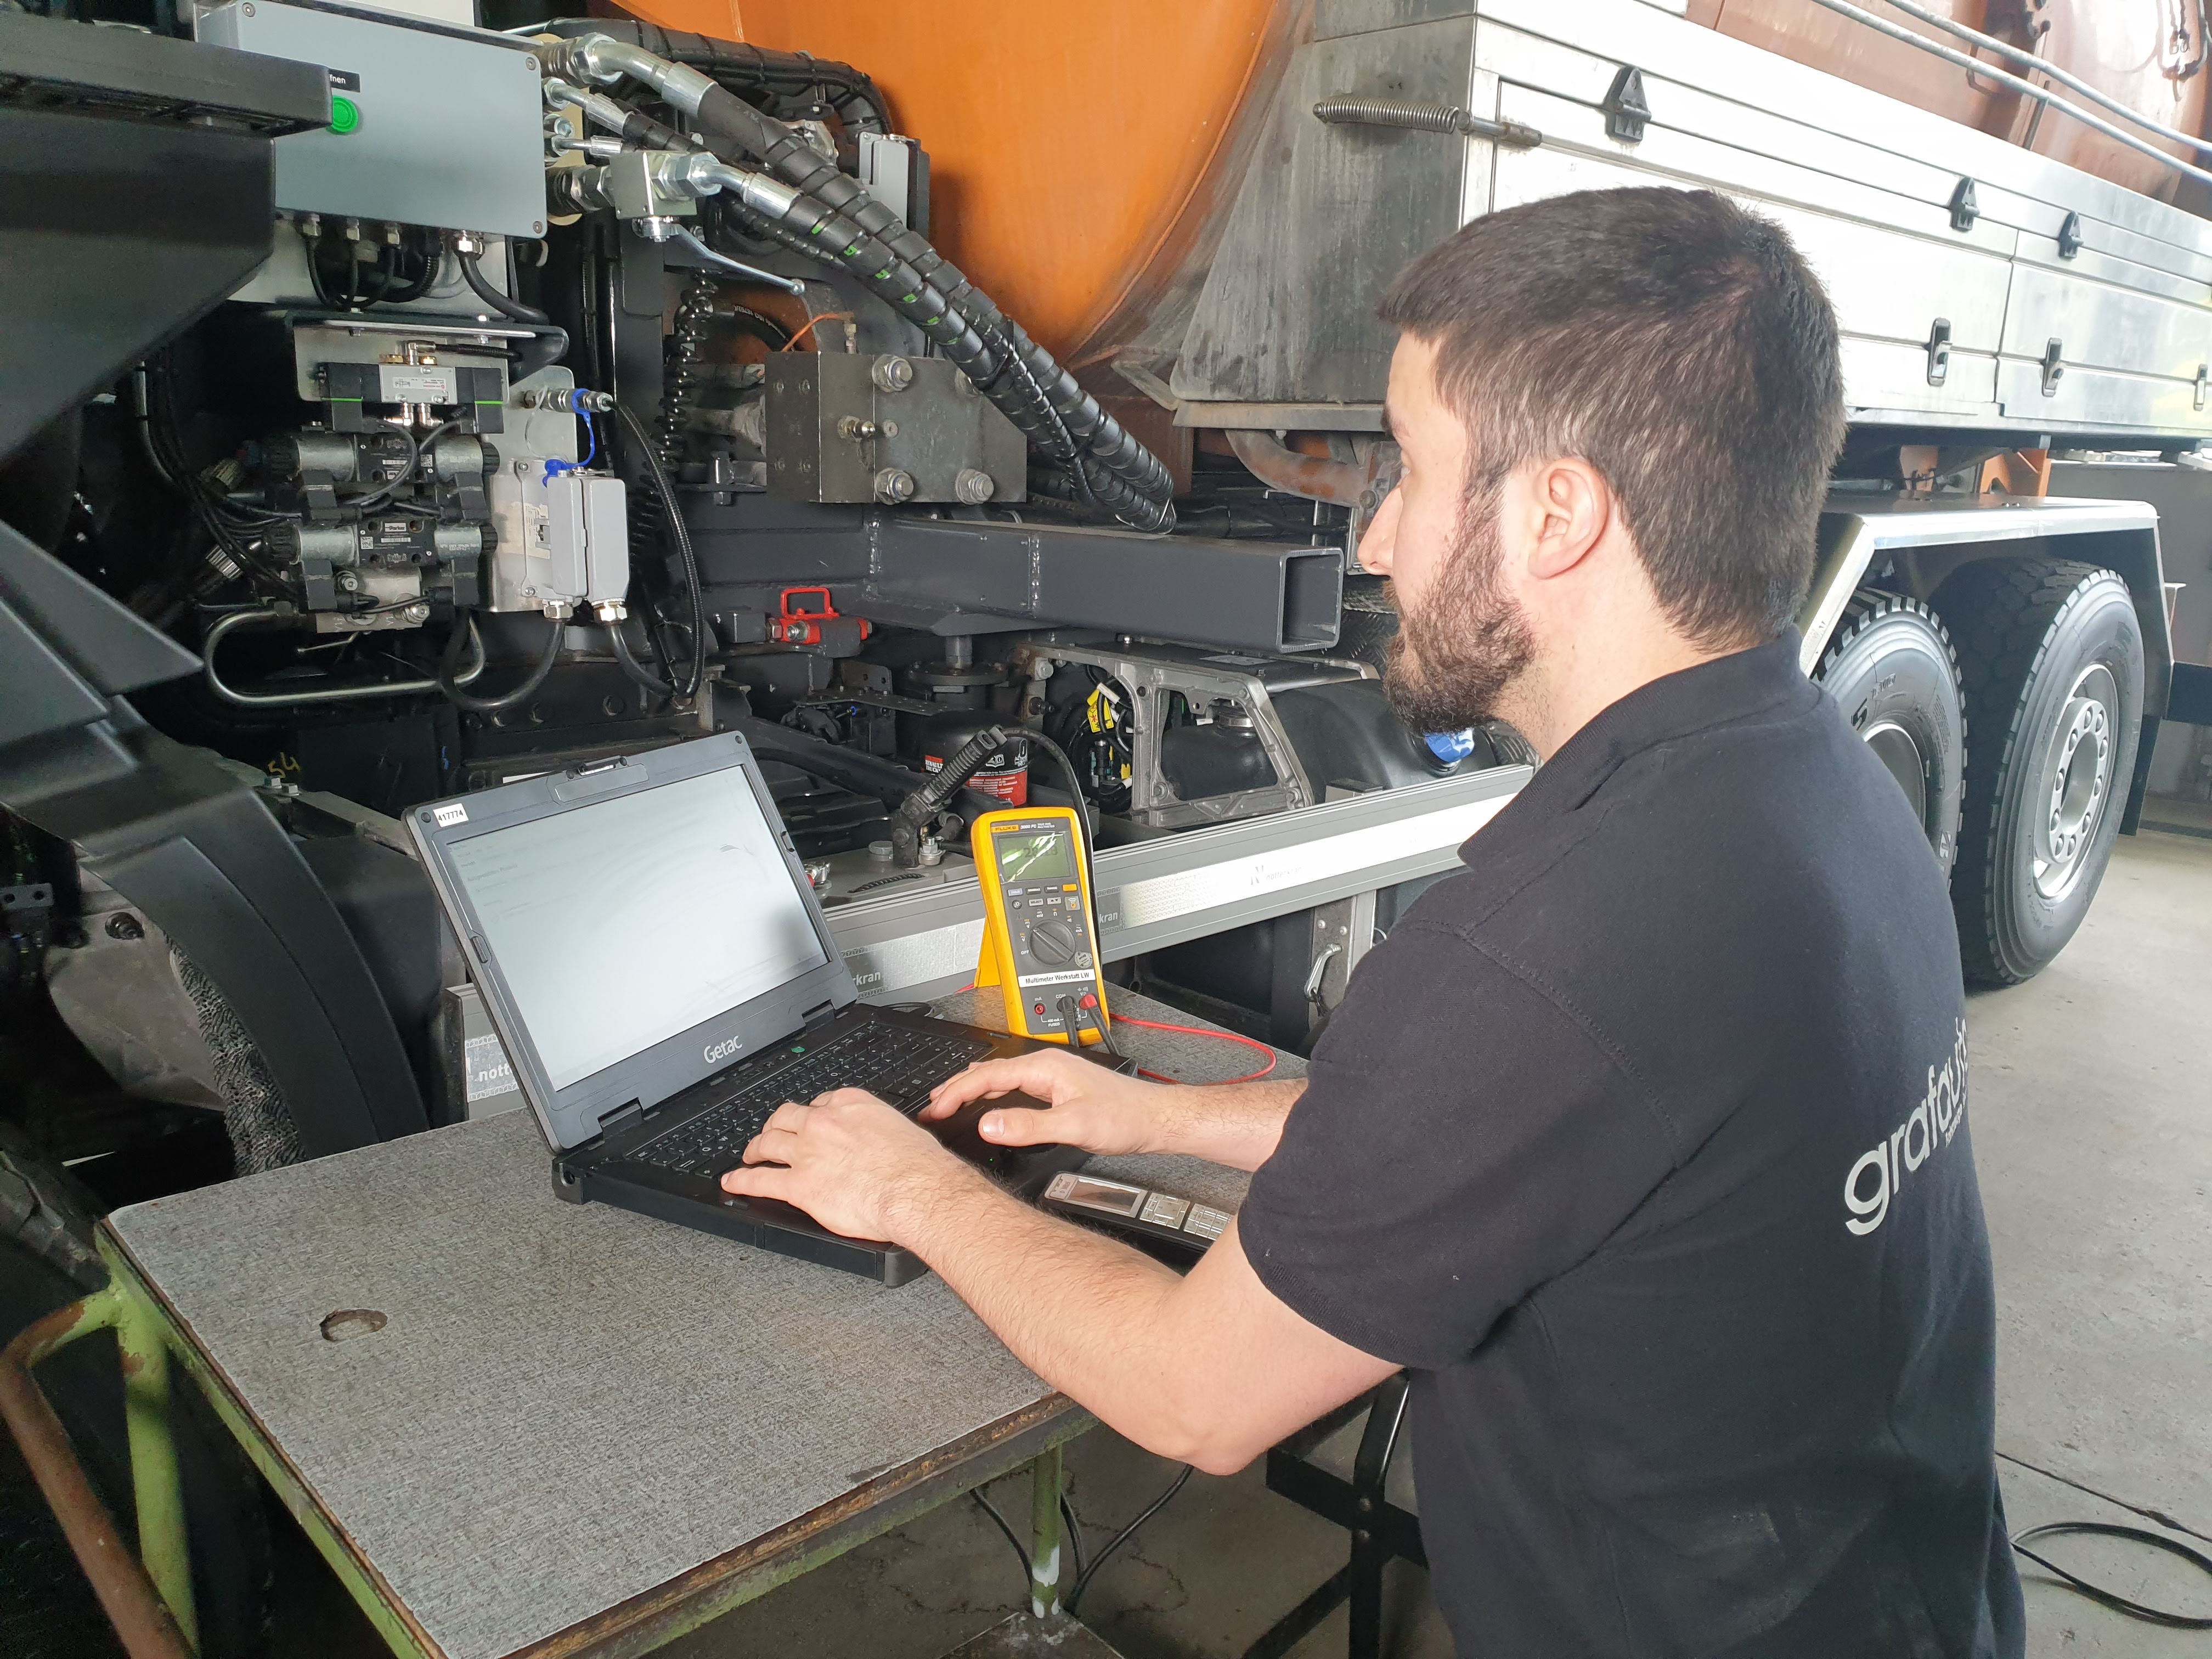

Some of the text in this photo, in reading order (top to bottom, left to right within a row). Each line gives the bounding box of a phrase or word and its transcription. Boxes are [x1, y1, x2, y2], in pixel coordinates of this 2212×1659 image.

[926, 765, 941, 774] TRUCK
[438, 810, 463, 821] 417774
[853, 972, 881, 986] kran
[704, 1035, 743, 1063] Getac
[479, 1063, 513, 1082] nott
